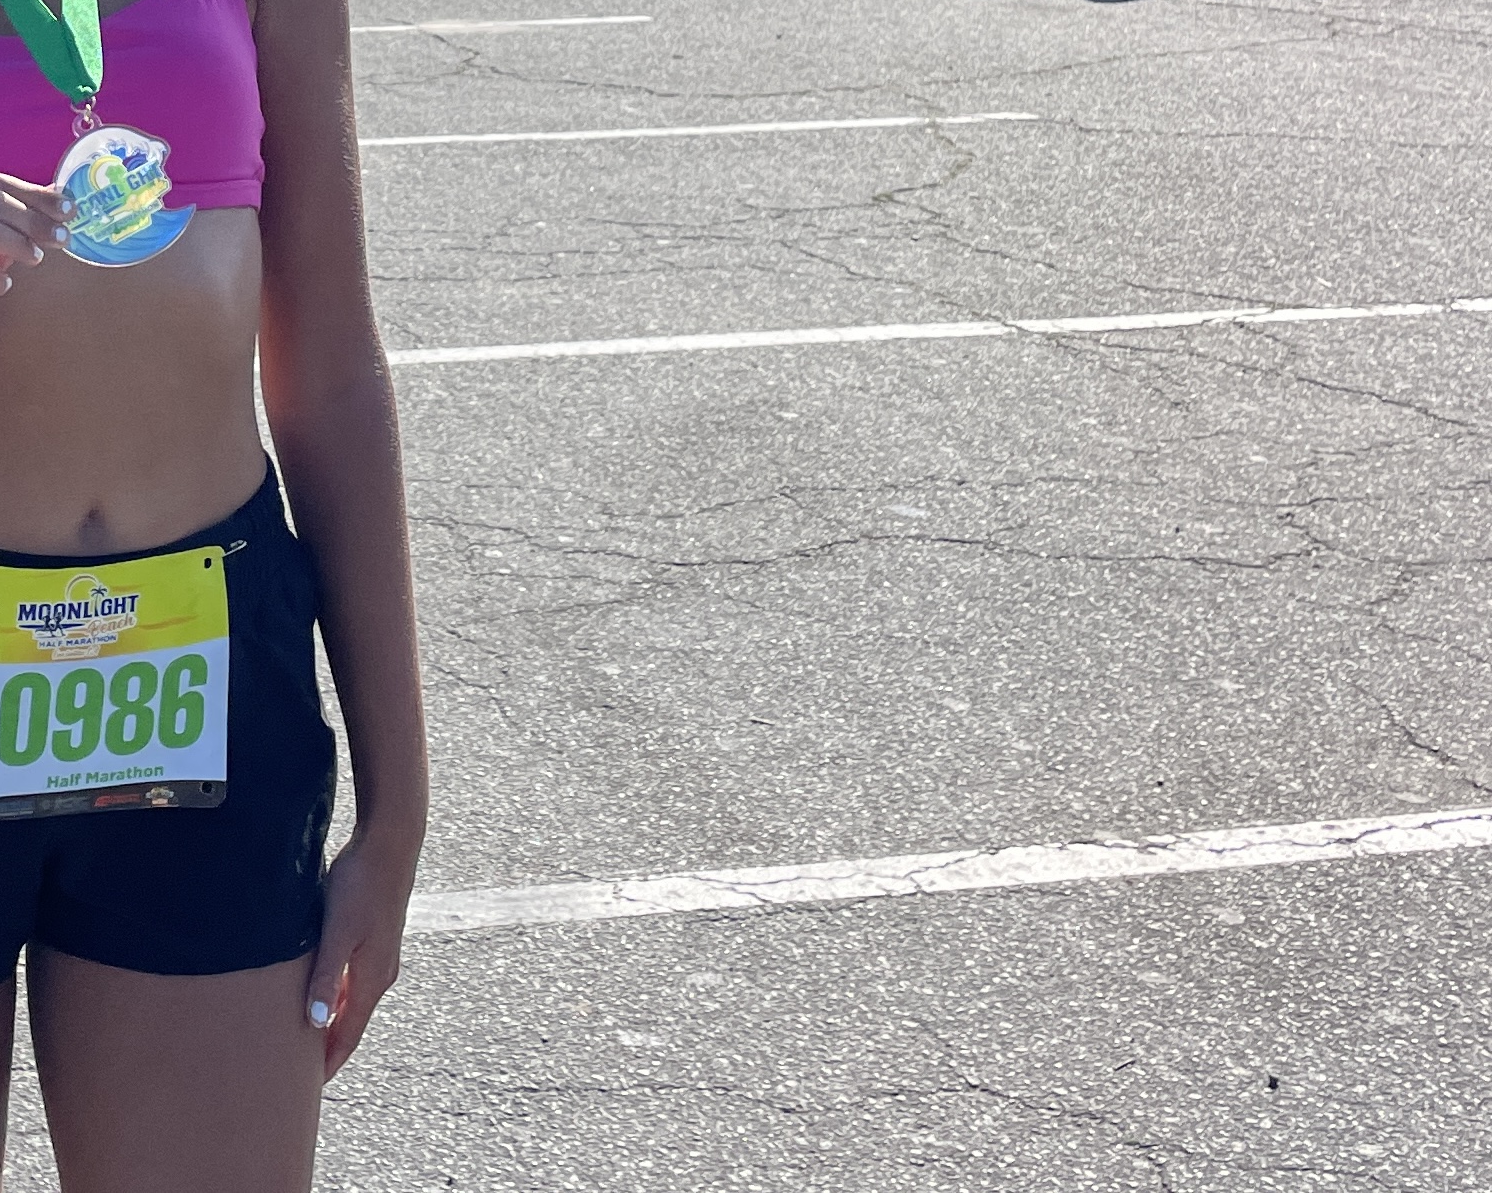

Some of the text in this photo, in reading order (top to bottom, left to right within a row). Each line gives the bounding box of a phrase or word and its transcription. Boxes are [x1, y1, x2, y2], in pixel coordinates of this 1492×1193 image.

[17, 594, 140, 622] MOONLIGHT
[87, 613, 135, 637] Beach
[38, 634, 117, 648] HALF MARATHON
[46, 764, 165, 790] Half Marathon
